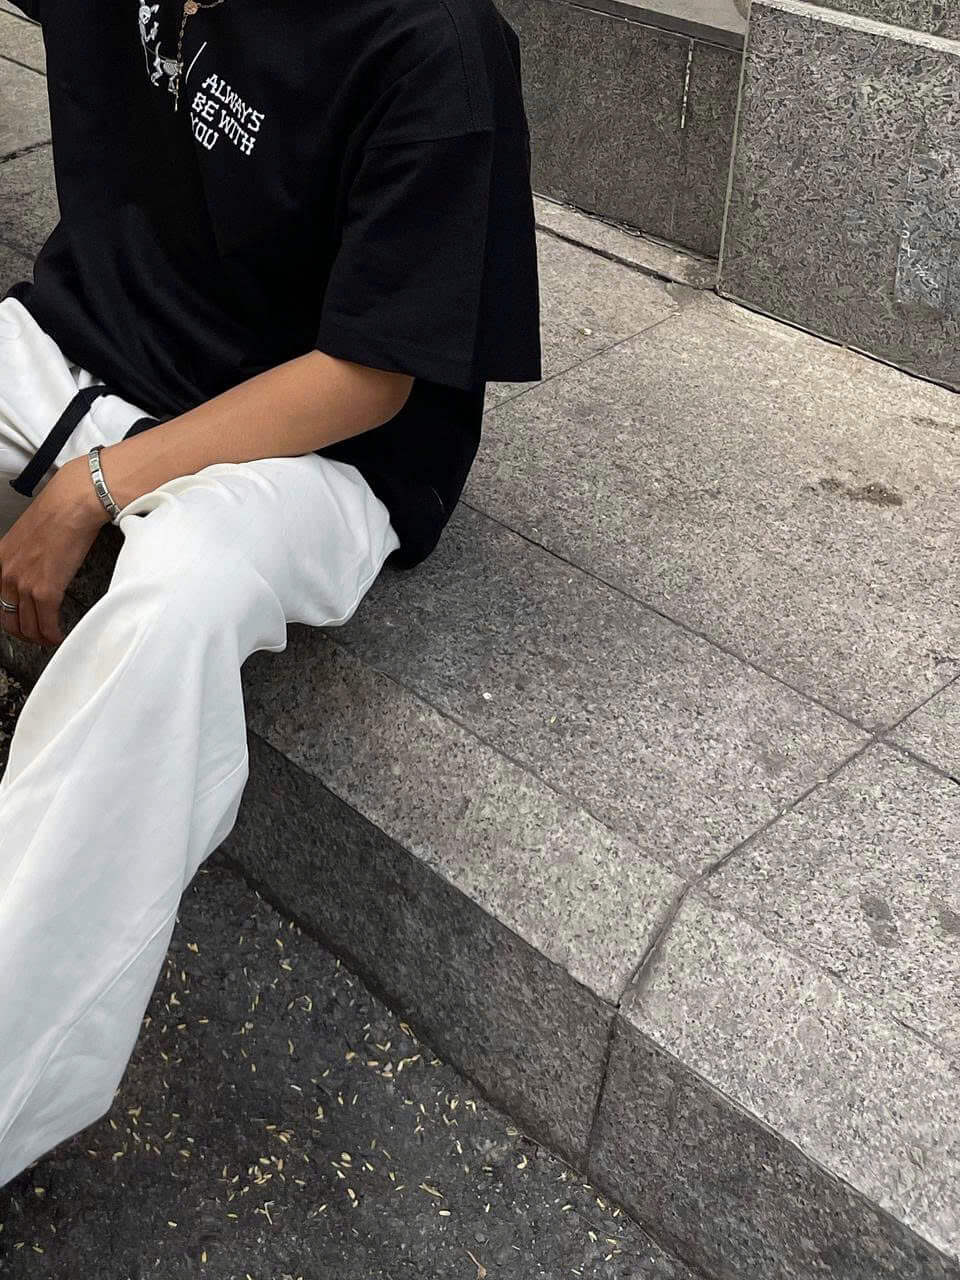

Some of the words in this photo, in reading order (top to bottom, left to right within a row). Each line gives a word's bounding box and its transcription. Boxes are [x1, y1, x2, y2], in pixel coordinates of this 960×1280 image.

[191, 91, 220, 122] BE
[218, 109, 256, 156] WITH
[191, 111, 219, 151] YOU
[202, 73, 265, 132] ALWAYS
